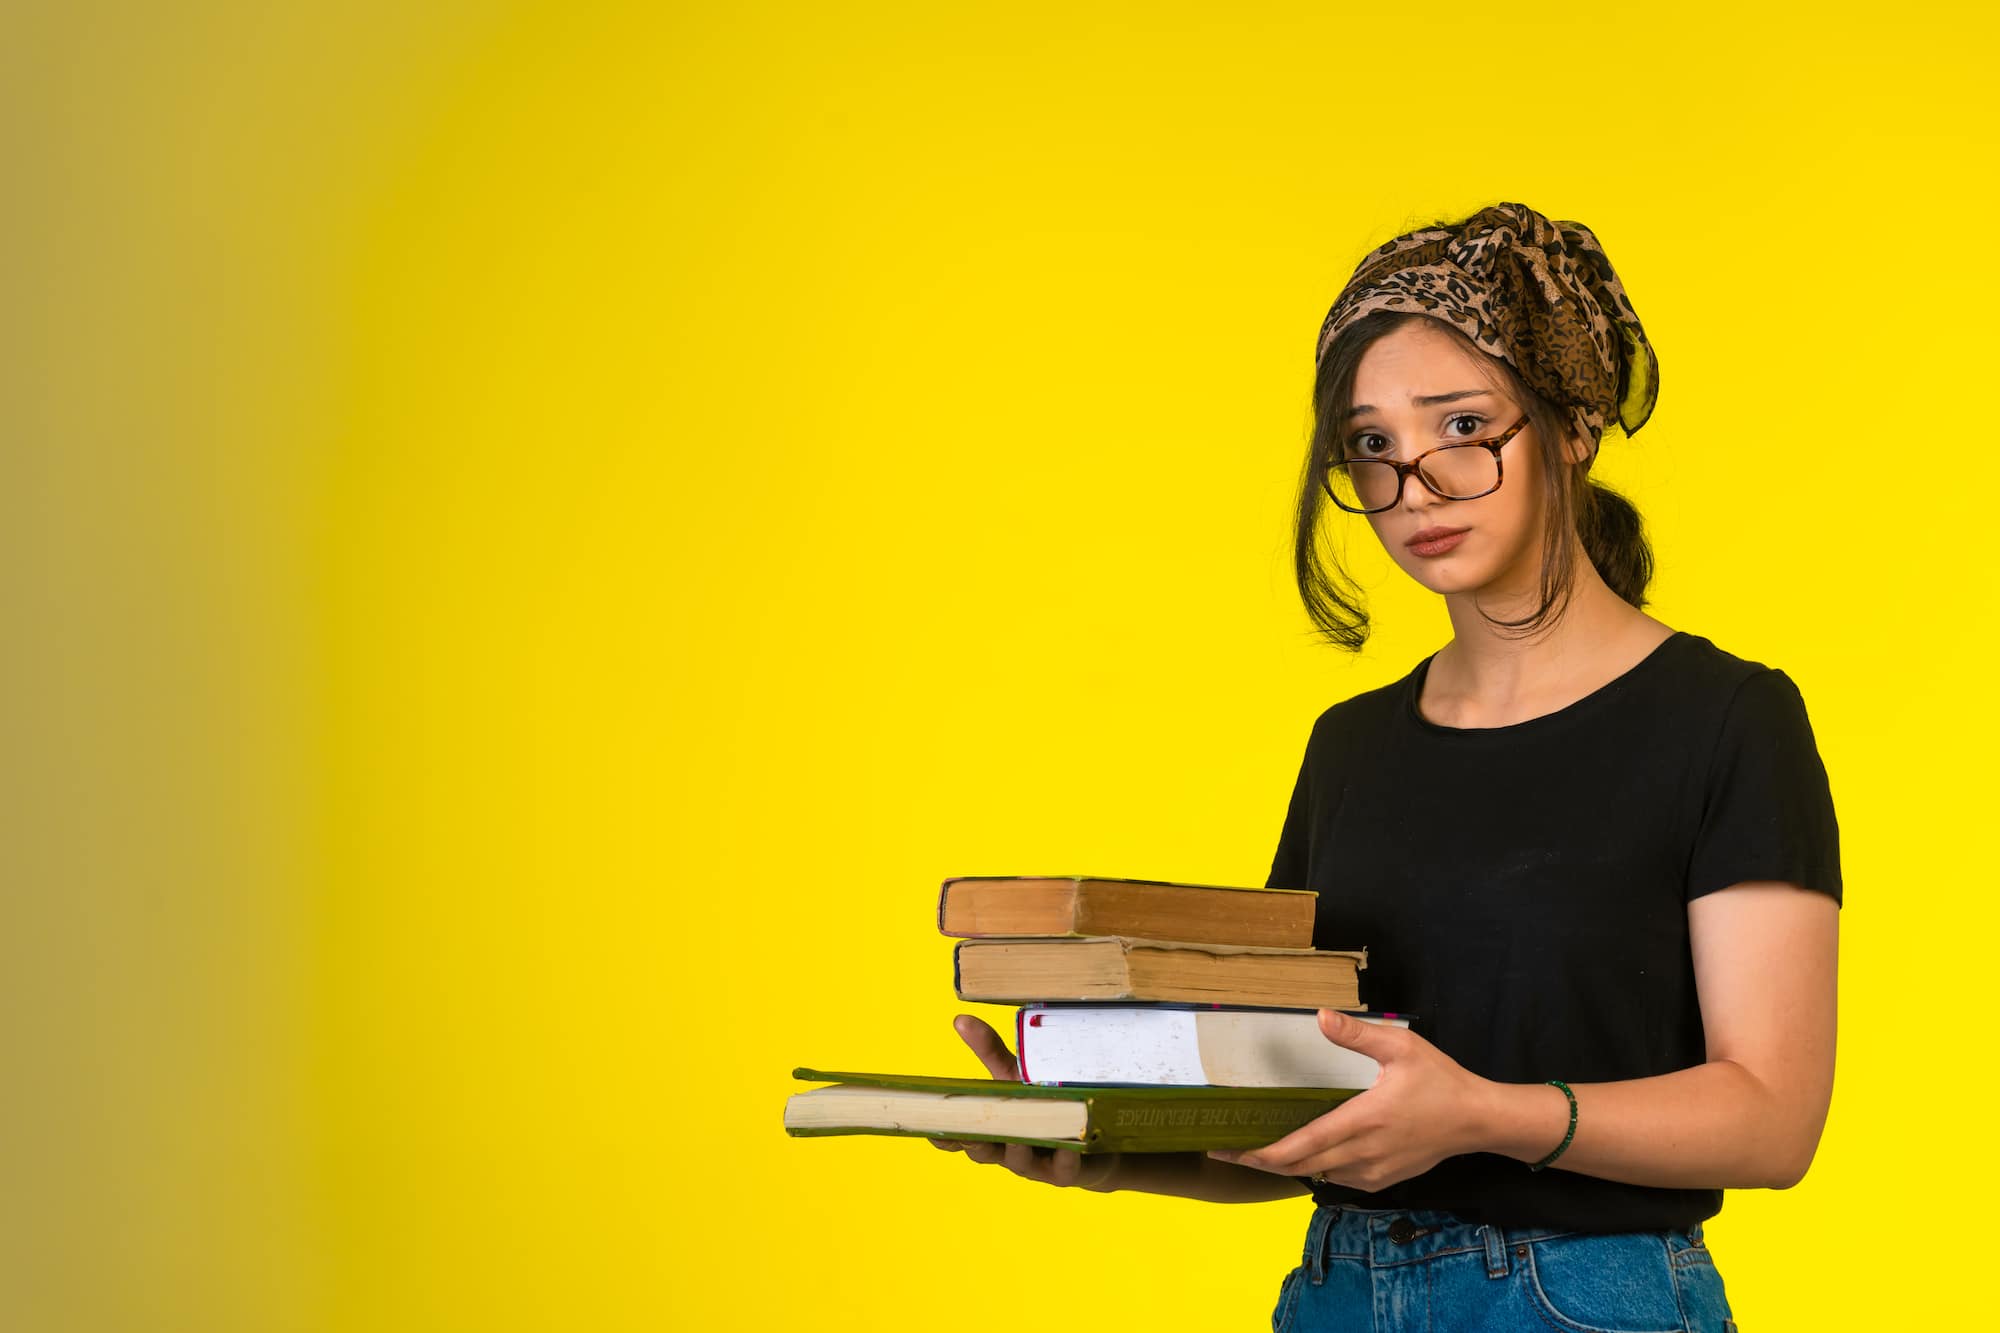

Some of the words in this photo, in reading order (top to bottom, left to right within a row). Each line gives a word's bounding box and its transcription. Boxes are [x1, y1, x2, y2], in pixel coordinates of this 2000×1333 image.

[1116, 1108, 1198, 1127] HERMITAGE
[1200, 1108, 1229, 1126] THE
[1232, 1108, 1249, 1125] IN
